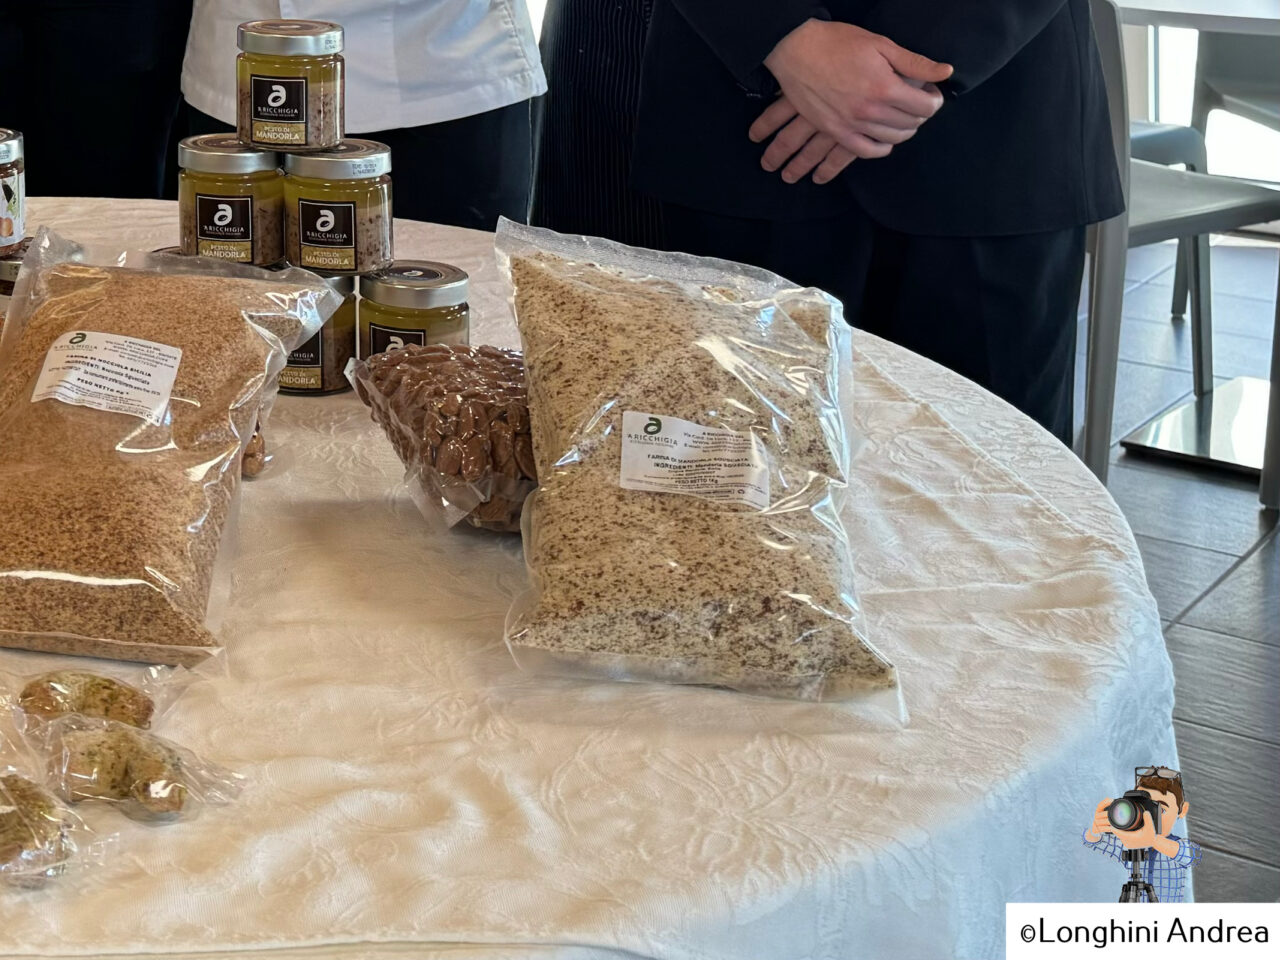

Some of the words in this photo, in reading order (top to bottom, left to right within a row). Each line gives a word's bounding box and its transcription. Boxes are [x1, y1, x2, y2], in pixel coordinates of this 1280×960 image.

[256, 130, 300, 141] MANDORLA
[202, 249, 247, 259] MANDORLA
[305, 255, 350, 266] MANDORLA
[76, 377, 93, 386] PESO
[94, 382, 114, 392] NETTO
[277, 375, 316, 385] ANDORLA
[647, 453, 670, 461] FARINA
